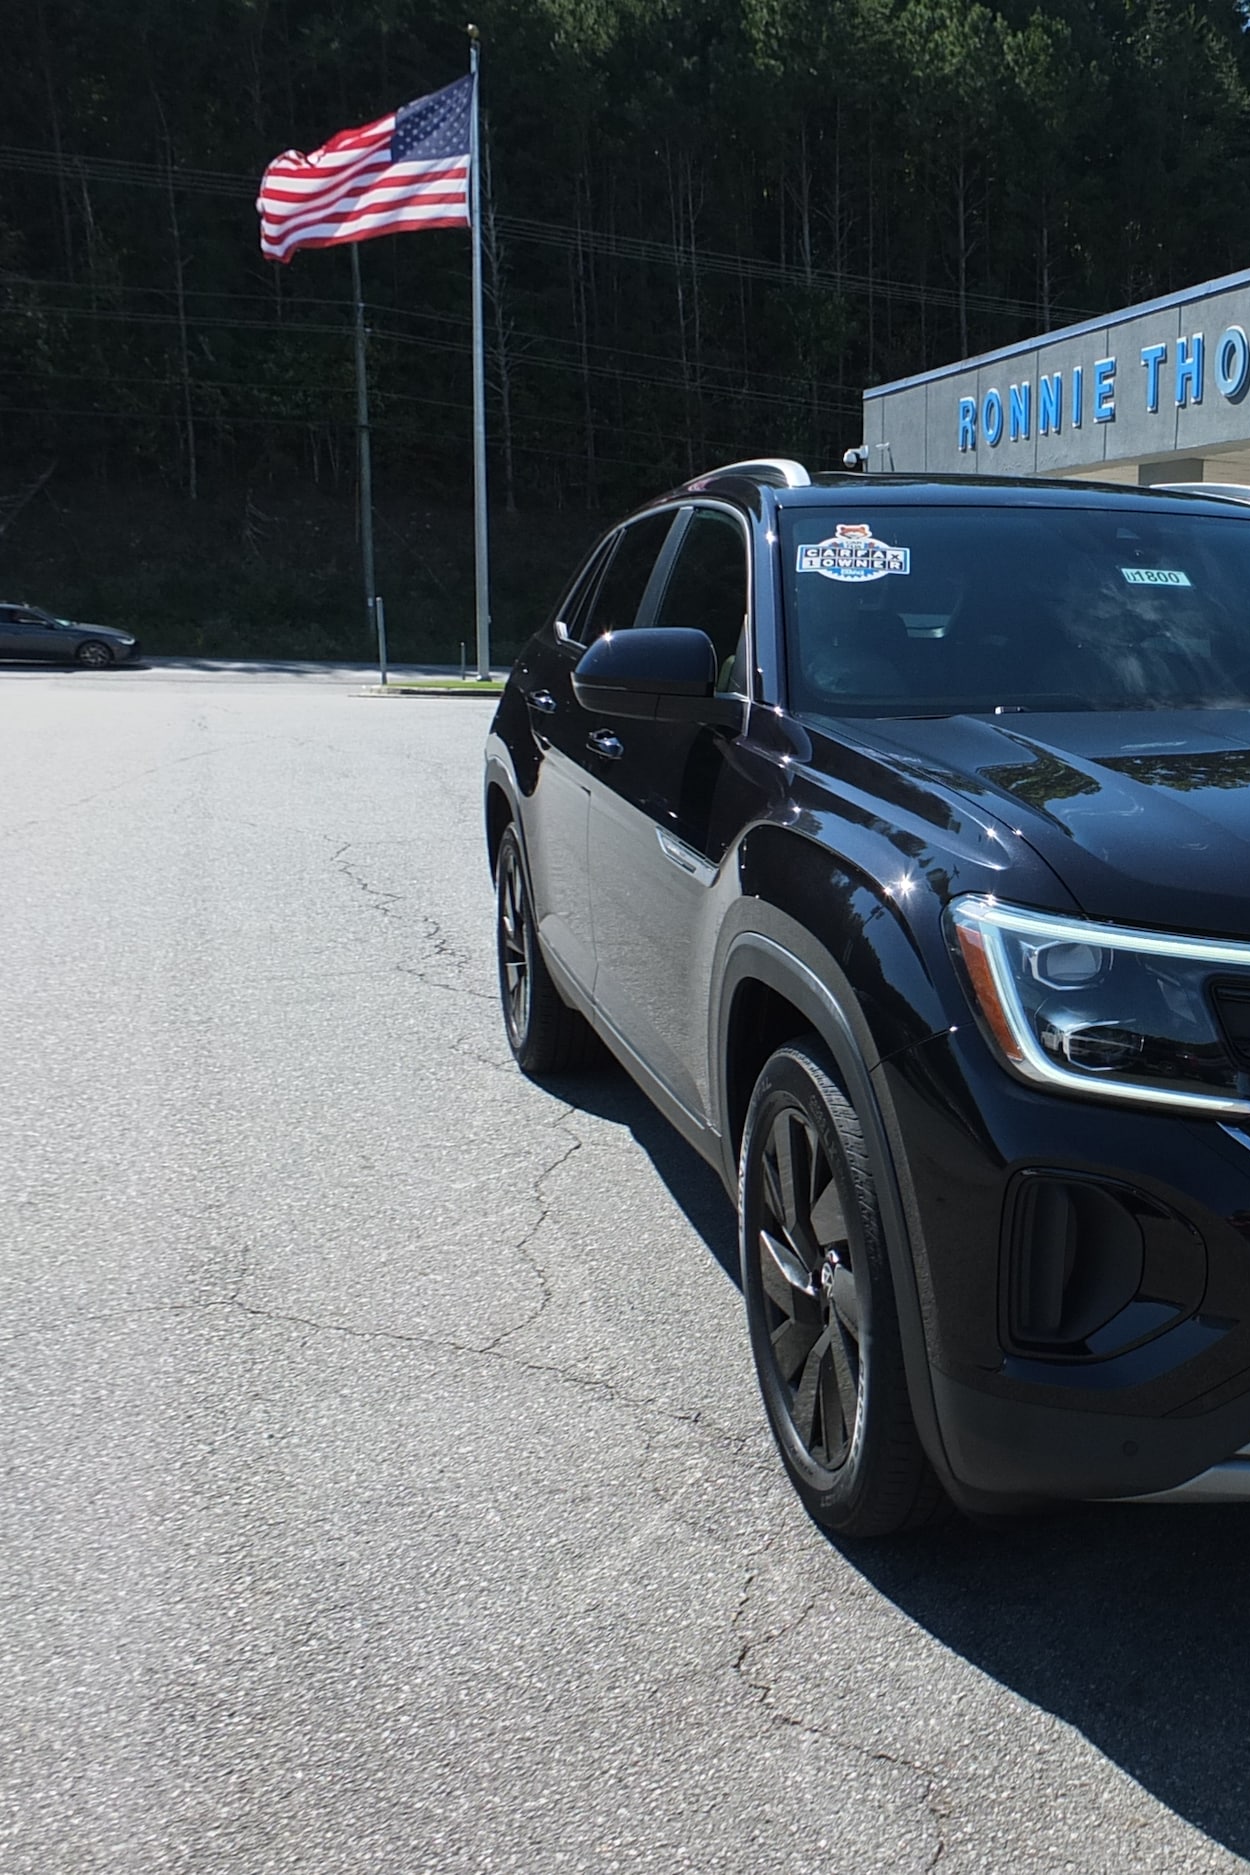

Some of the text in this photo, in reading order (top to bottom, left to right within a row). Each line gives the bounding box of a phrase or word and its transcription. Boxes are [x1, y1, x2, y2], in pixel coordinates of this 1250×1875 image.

[958, 355, 1117, 453] RONNIE
[805, 548, 902, 561] CARFAX
[822, 558, 902, 570] OWNER
